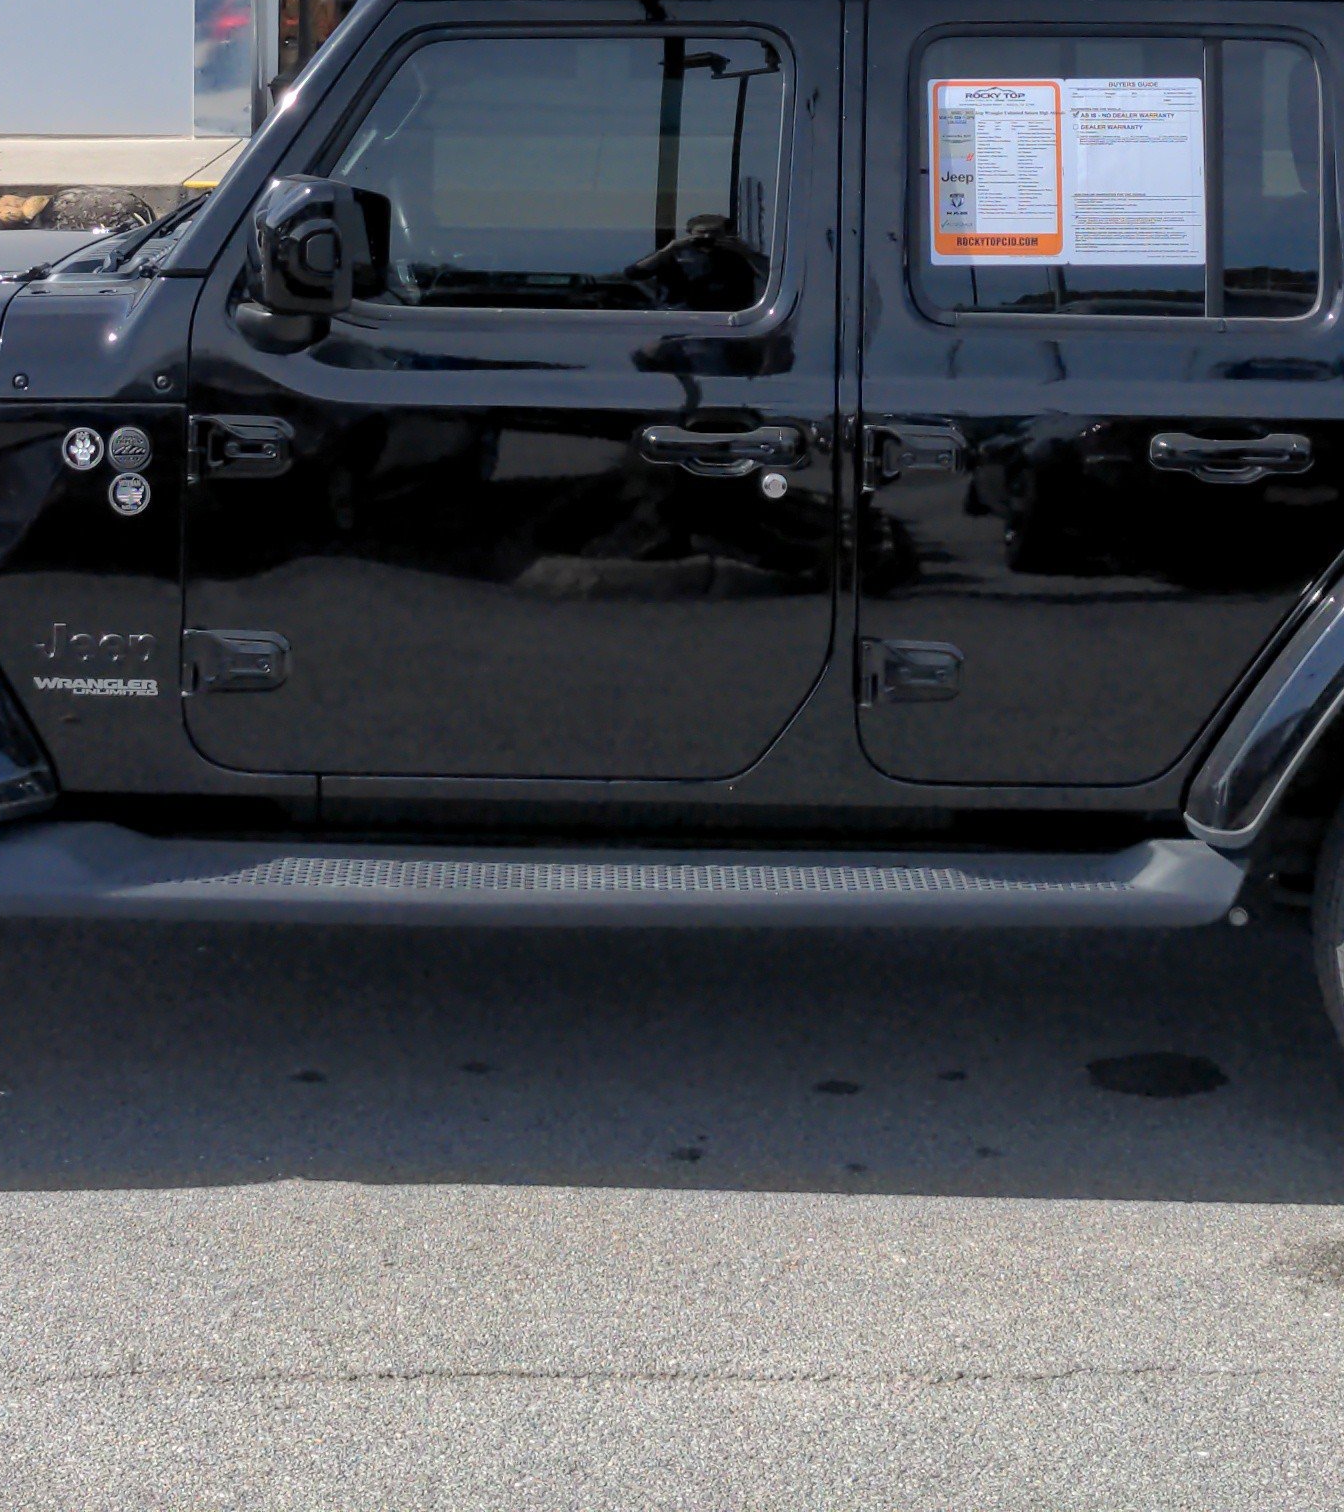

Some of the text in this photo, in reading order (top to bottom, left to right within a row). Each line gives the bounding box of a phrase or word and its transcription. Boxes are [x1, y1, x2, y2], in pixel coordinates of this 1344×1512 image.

[941, 171, 974, 184] Jeep
[33, 677, 158, 689] WRANGLER
[73, 688, 159, 696] UNLIMITED
